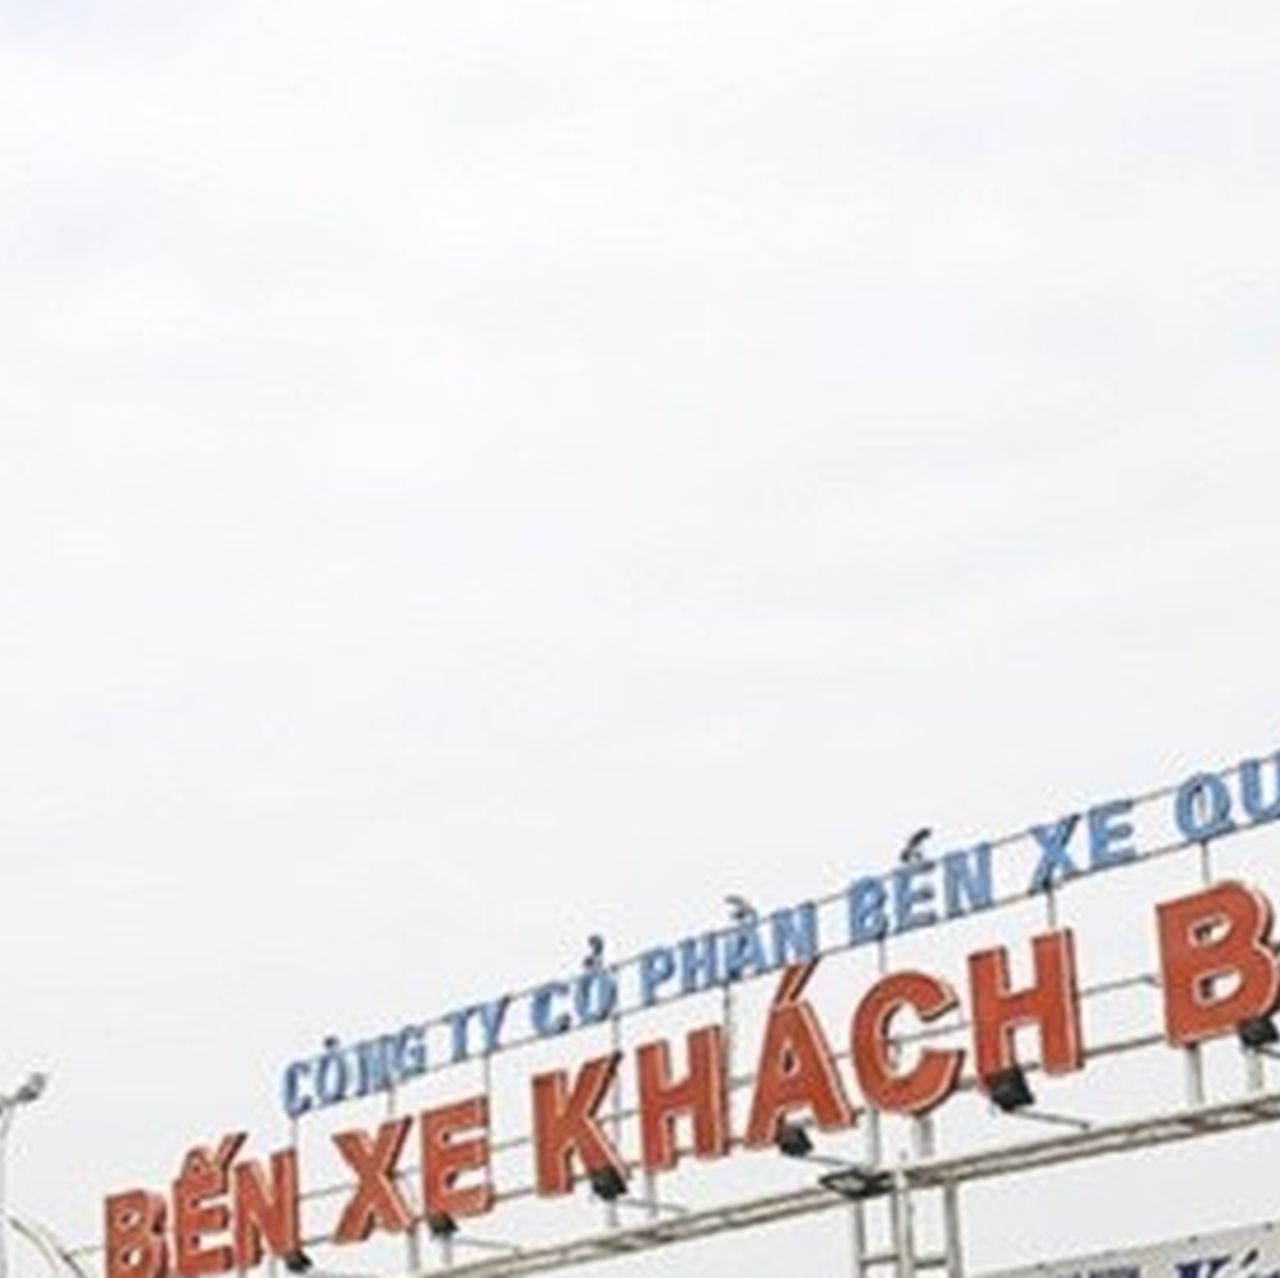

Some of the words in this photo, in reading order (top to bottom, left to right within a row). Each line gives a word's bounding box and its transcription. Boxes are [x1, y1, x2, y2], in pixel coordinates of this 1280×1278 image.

[281, 1037, 422, 1120] CÔNG
[450, 996, 512, 1062] TY
[531, 934, 618, 1037] CỔ
[639, 897, 820, 1006] PHẦN
[848, 828, 996, 947] BẾN
[1029, 800, 1139, 892] XE
[332, 1094, 495, 1245] XE
[531, 956, 1085, 1199] KHÁCH
